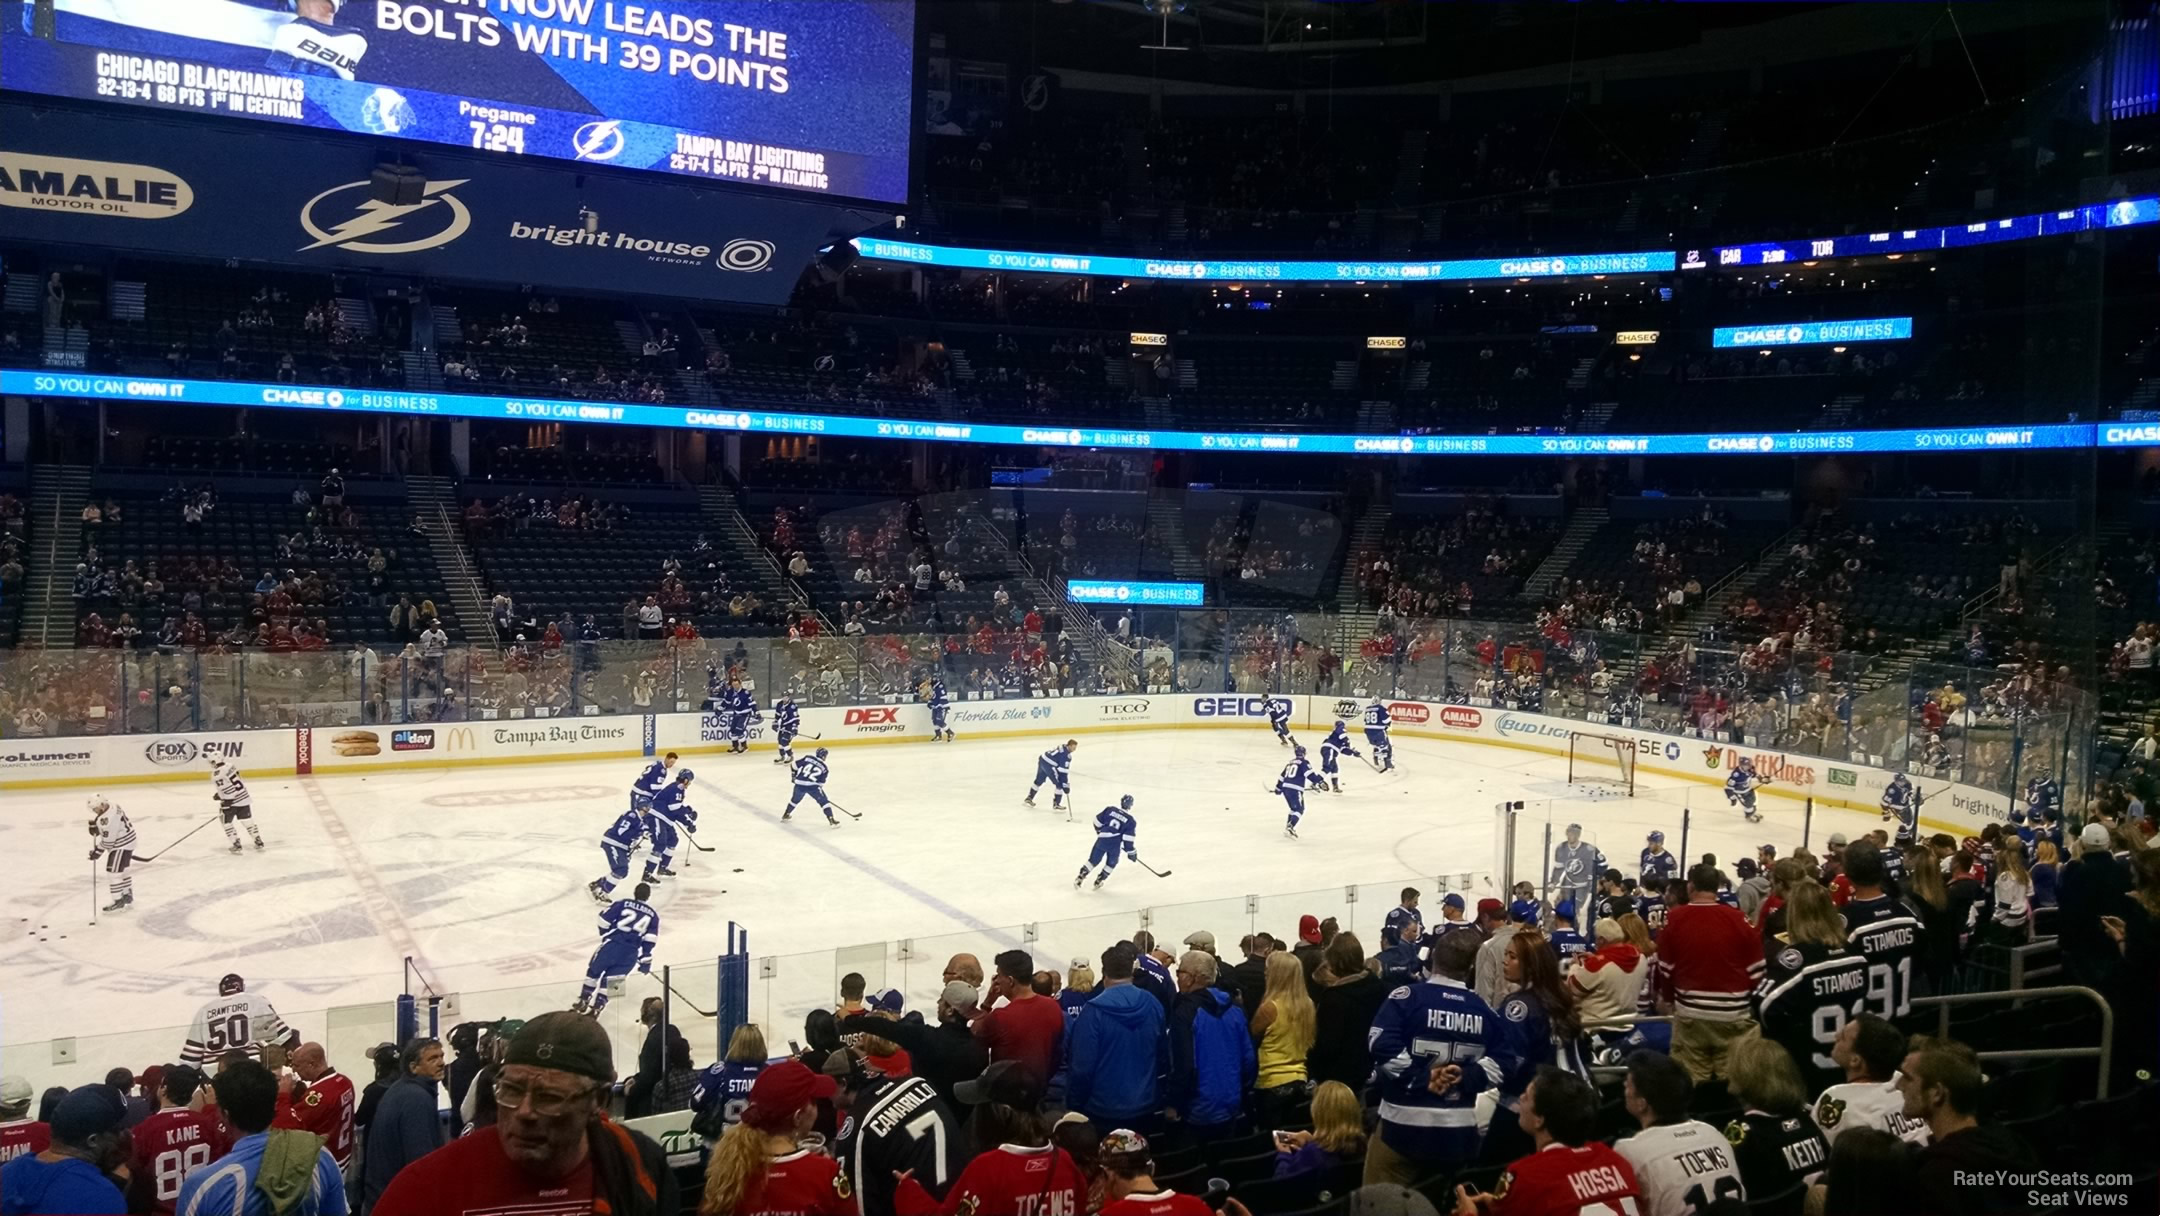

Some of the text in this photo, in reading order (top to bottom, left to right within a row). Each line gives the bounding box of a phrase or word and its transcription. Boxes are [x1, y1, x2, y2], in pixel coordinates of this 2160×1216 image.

[605, 3, 714, 47] LEADS
[724, 24, 787, 60] THE
[377, 0, 789, 93] BOLTS WITH 39 POINTS
[97, 52, 304, 101] CHICAGO BLACKHAWKS
[98, 77, 151, 100] 32-13-4
[179, 88, 205, 107] PTS
[230, 96, 243, 112] IN
[246, 98, 304, 119] CENTRAL
[459, 101, 535, 125] Pregame
[470, 121, 524, 153] 7:24
[676, 134, 824, 173] TAMPA BAY LIGHTNING
[729, 162, 749, 178] PTS
[782, 169, 828, 189] ATLANTIC
[0, 166, 177, 206] AMALIE
[31, 197, 129, 213] MOTOR OIL
[510, 222, 711, 257] bright house
[648, 256, 702, 265] NETWORKS
[875, 244, 933, 261] BUSINESS
[988, 254, 1091, 270] SO YOU CAN OWN IT
[1720, 240, 1834, 265] CAR TOR
[1146, 263, 1280, 277] CHASE BUSINESS
[1337, 266, 1351, 277] SO
[1354, 266, 1374, 277] YOU
[1378, 266, 1399, 277] CAN
[1430, 265, 1442, 276] IT
[1501, 257, 1648, 274] CHASE BUSINESS
[1131, 335, 1158, 344] CHASE
[1367, 338, 1398, 347] CHASE
[1617, 334, 1650, 342] CHASE
[1734, 324, 1893, 344] CHASE BUSINESS
[35, 377, 185, 397] SO YOU CAN OWN IT
[263, 388, 437, 411] CHASE for BUSINESS
[505, 402, 624, 419] SO YOU CAN OWN IT
[686, 411, 737, 427] CHASE
[764, 416, 824, 431] BUSINESS
[877, 423, 891, 434] SO
[893, 424, 912, 435] YOU
[914, 425, 934, 436] CAN
[1023, 430, 1068, 443] CHASE
[1094, 433, 1150, 445] BUSINESS
[1201, 435, 1215, 448] SO
[1216, 436, 1236, 448] YOU
[1239, 437, 1259, 448] CAN
[1708, 438, 1758, 450] CHASE
[1789, 436, 1854, 449] BUSINESS
[1915, 431, 2033, 447] SO YOU CAN OWN IT
[2106, 426, 2160, 442] CHAS
[1354, 439, 1399, 450] CHASE
[1426, 440, 1486, 451] BUSINESS
[1543, 440, 1558, 451] SO
[1560, 440, 1581, 451] YOU
[1584, 440, 1605, 451] CAN
[1637, 439, 1649, 450] IT
[1072, 586, 1199, 600] CHASE BUSINESS
[844, 707, 901, 725] DEX
[953, 708, 1027, 723] Florida Blue
[1100, 703, 1148, 714] TECO
[1390, 706, 1428, 719] AMALIE
[1443, 710, 1480, 724] AMALIE
[494, 725, 625, 746] Tampa Bay Times
[645, 715, 653, 748] Reebok
[701, 729, 764, 741] RADIOOGY
[857, 723, 905, 733] imaging
[1501, 718, 1537, 734] BUD
[299, 729, 309, 765] Reebok
[394, 732, 431, 746] allday
[157, 743, 187, 755] FOX
[202, 742, 243, 758] SUN
[803, 764, 822, 782] 42
[1727, 749, 1815, 786] DftKings
[1831, 770, 1855, 784] USF
[1952, 794, 1990, 816] bright
[617, 910, 651, 936] 24
[1863, 927, 1913, 954] STAMKOS
[1813, 968, 1863, 996] STAMKOS
[1867, 957, 1911, 1020] 91
[207, 1002, 248, 1019] CRAWFORD
[1428, 1009, 1483, 1035] HEDMAN
[207, 1014, 249, 1050] 50
[1412, 1037, 1486, 1068] 77
[870, 1083, 937, 1138] CAMARILLO
[166, 1125, 200, 1144] KANE
[905, 1110, 947, 1186] 7
[1781, 1136, 1825, 1171] KEITH
[1674, 1146, 1729, 1178] TOEWS
[155, 1143, 210, 1201] 88
[1568, 1165, 1627, 1200] HOSSA
[1015, 1189, 1074, 1216] TOEWS
